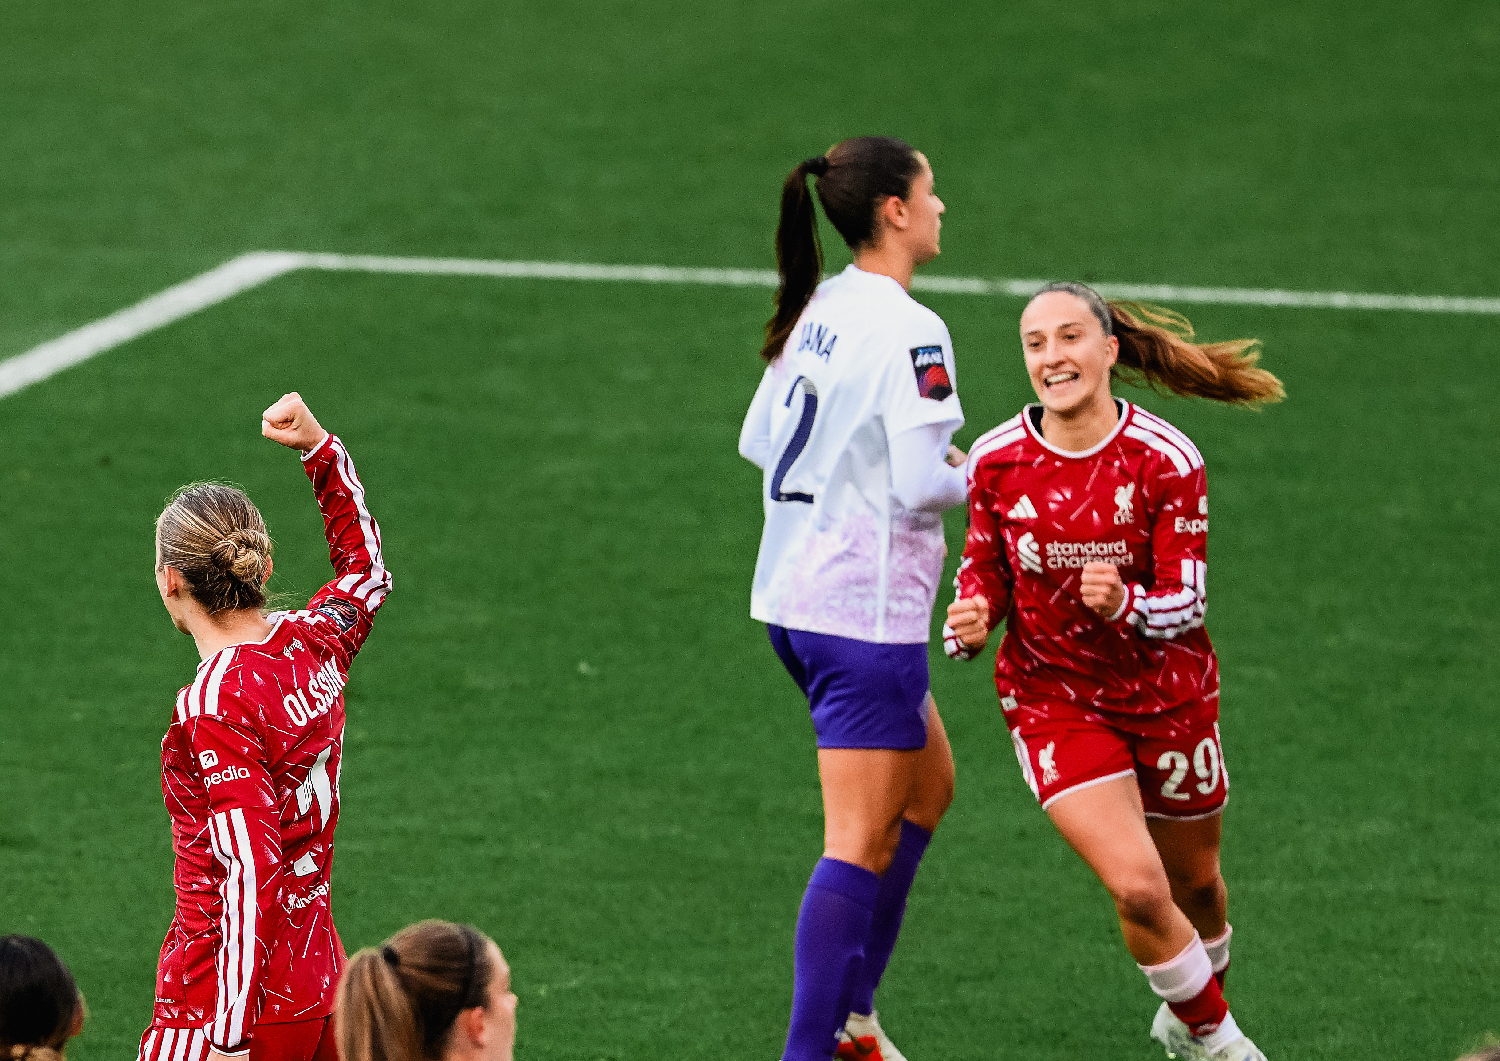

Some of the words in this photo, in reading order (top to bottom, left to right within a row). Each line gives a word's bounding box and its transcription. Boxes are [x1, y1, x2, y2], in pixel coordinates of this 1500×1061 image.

[771, 375, 818, 503] 2
[1045, 539, 1127, 556] standard
[1156, 737, 1220, 801] 29
